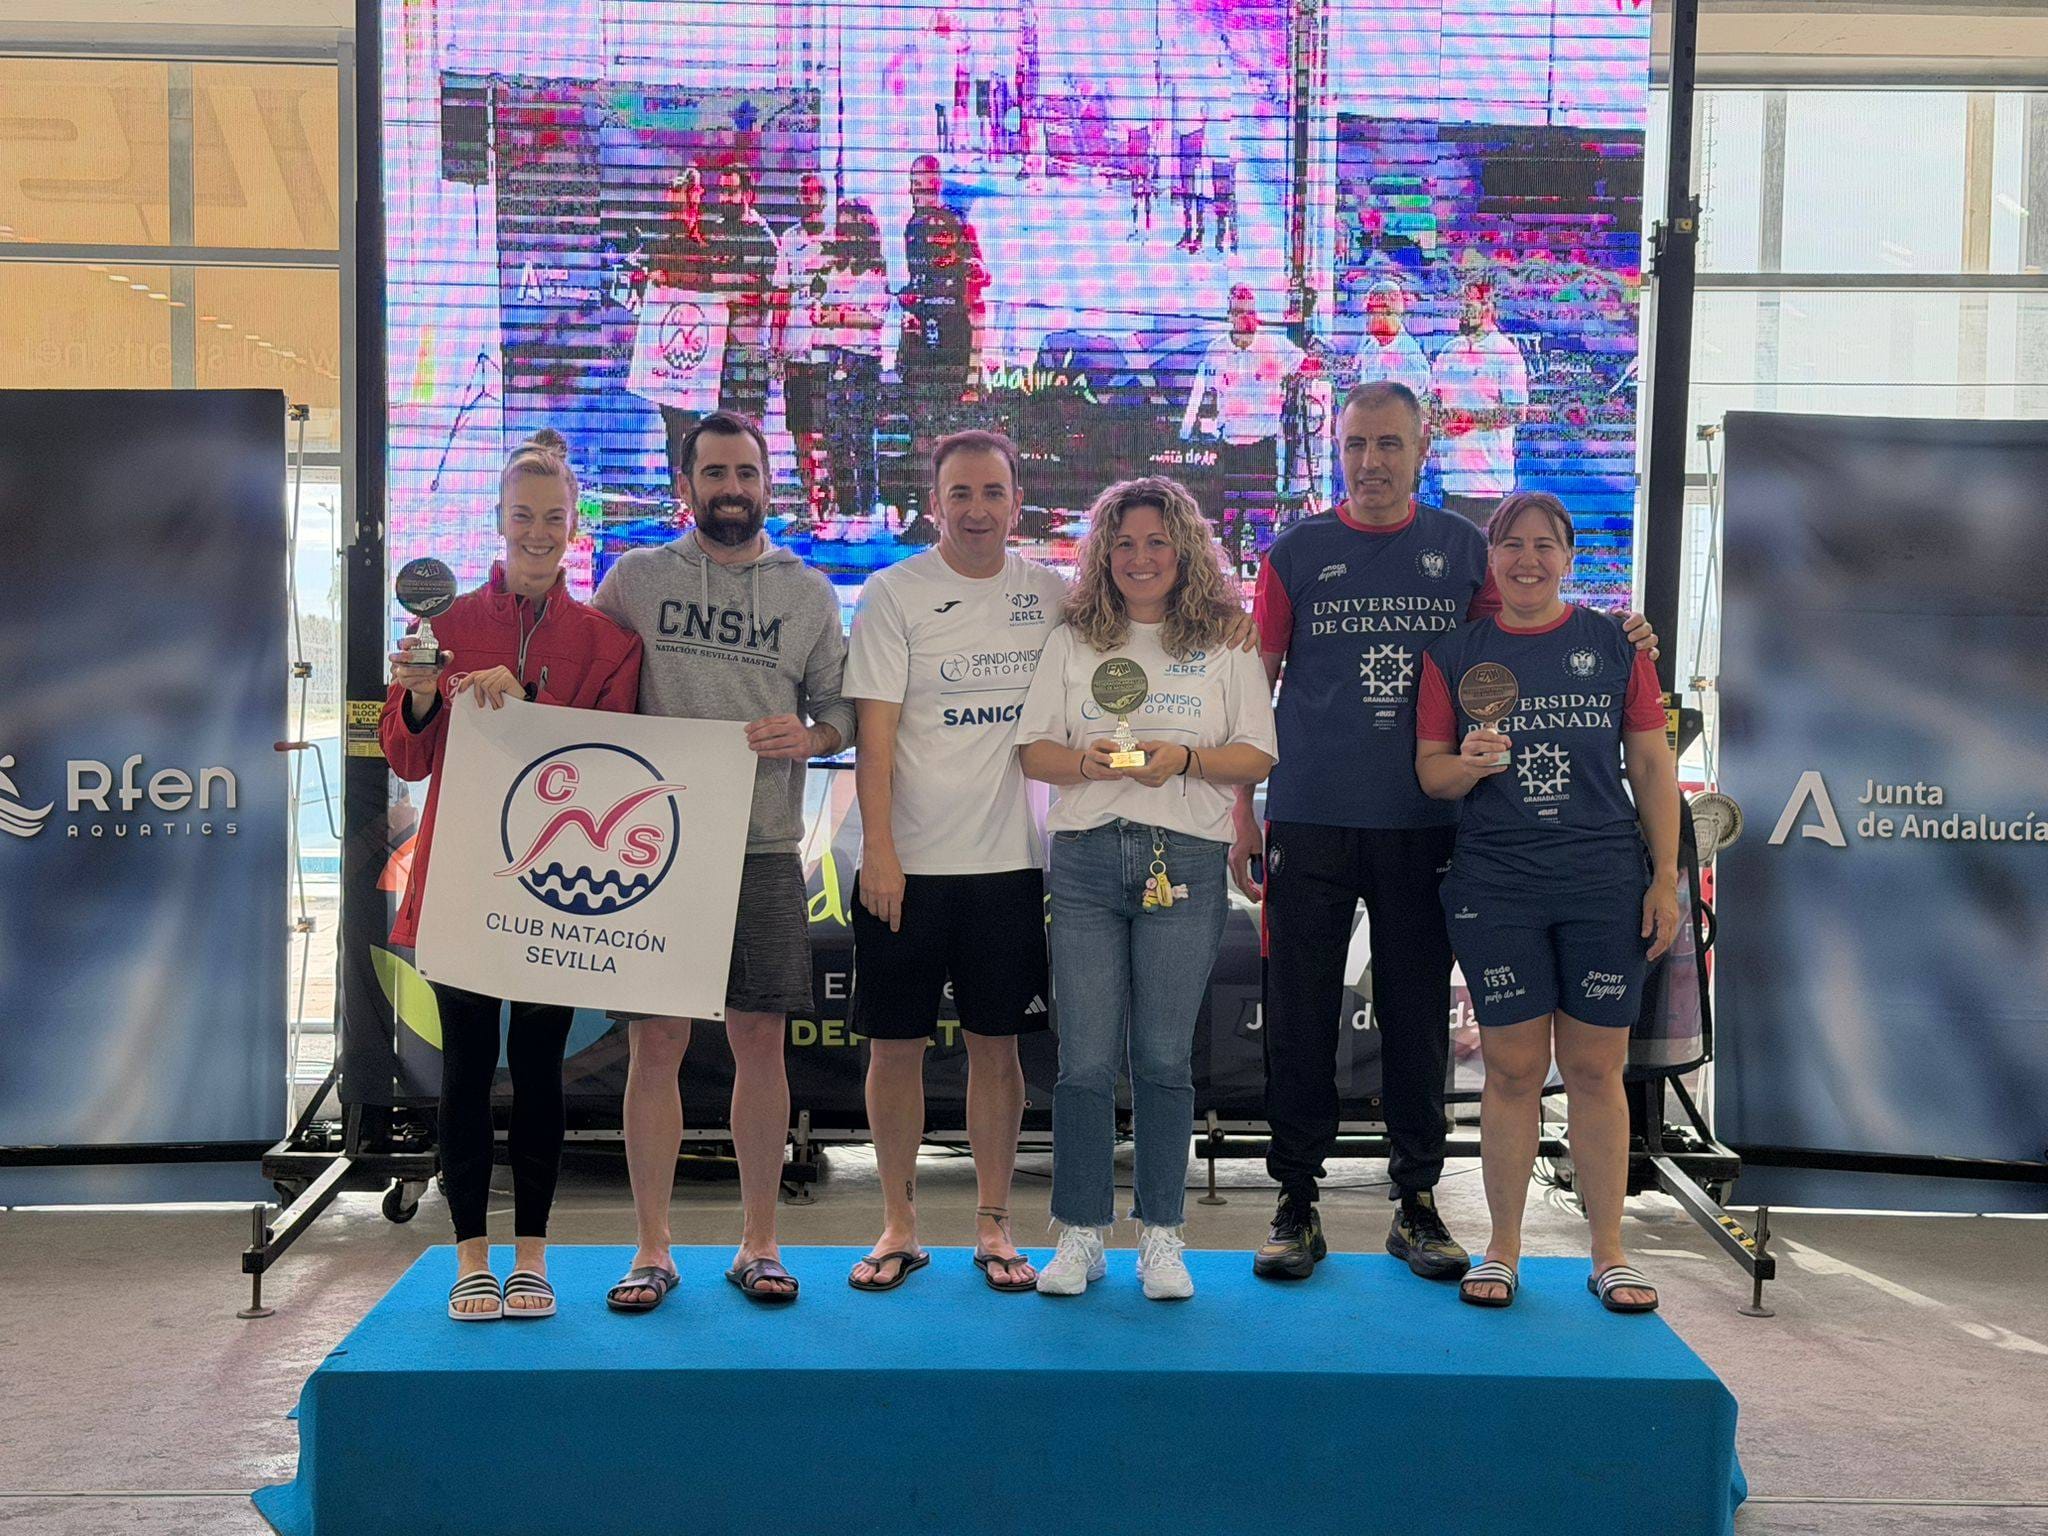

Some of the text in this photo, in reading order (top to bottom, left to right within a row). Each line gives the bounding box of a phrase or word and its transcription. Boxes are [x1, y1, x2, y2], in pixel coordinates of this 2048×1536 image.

[1009, 610, 1044, 622] JEREZ
[1313, 596, 1456, 616] UNIVERSIDAD
[657, 598, 785, 654] CNSM
[1312, 615, 1457, 636] DE GRANADA
[655, 644, 777, 669] NATACIÓN SEVILLA MASTER
[1164, 664, 1207, 674] JEREZ
[1495, 712, 1612, 734] GRANADA
[66, 753, 237, 812] Rfen
[1857, 779, 1944, 806] Junta
[67, 822, 237, 838] AQUATICS
[1857, 811, 2048, 842] de Andalucía
[486, 912, 666, 953] CLUB NATACIÓN
[525, 945, 617, 974] SEVILLA
[1484, 965, 1510, 976] desde
[1483, 972, 1516, 988] 1531
[1587, 970, 1624, 984] SPORT
[1581, 978, 1628, 1001] & Legacy
